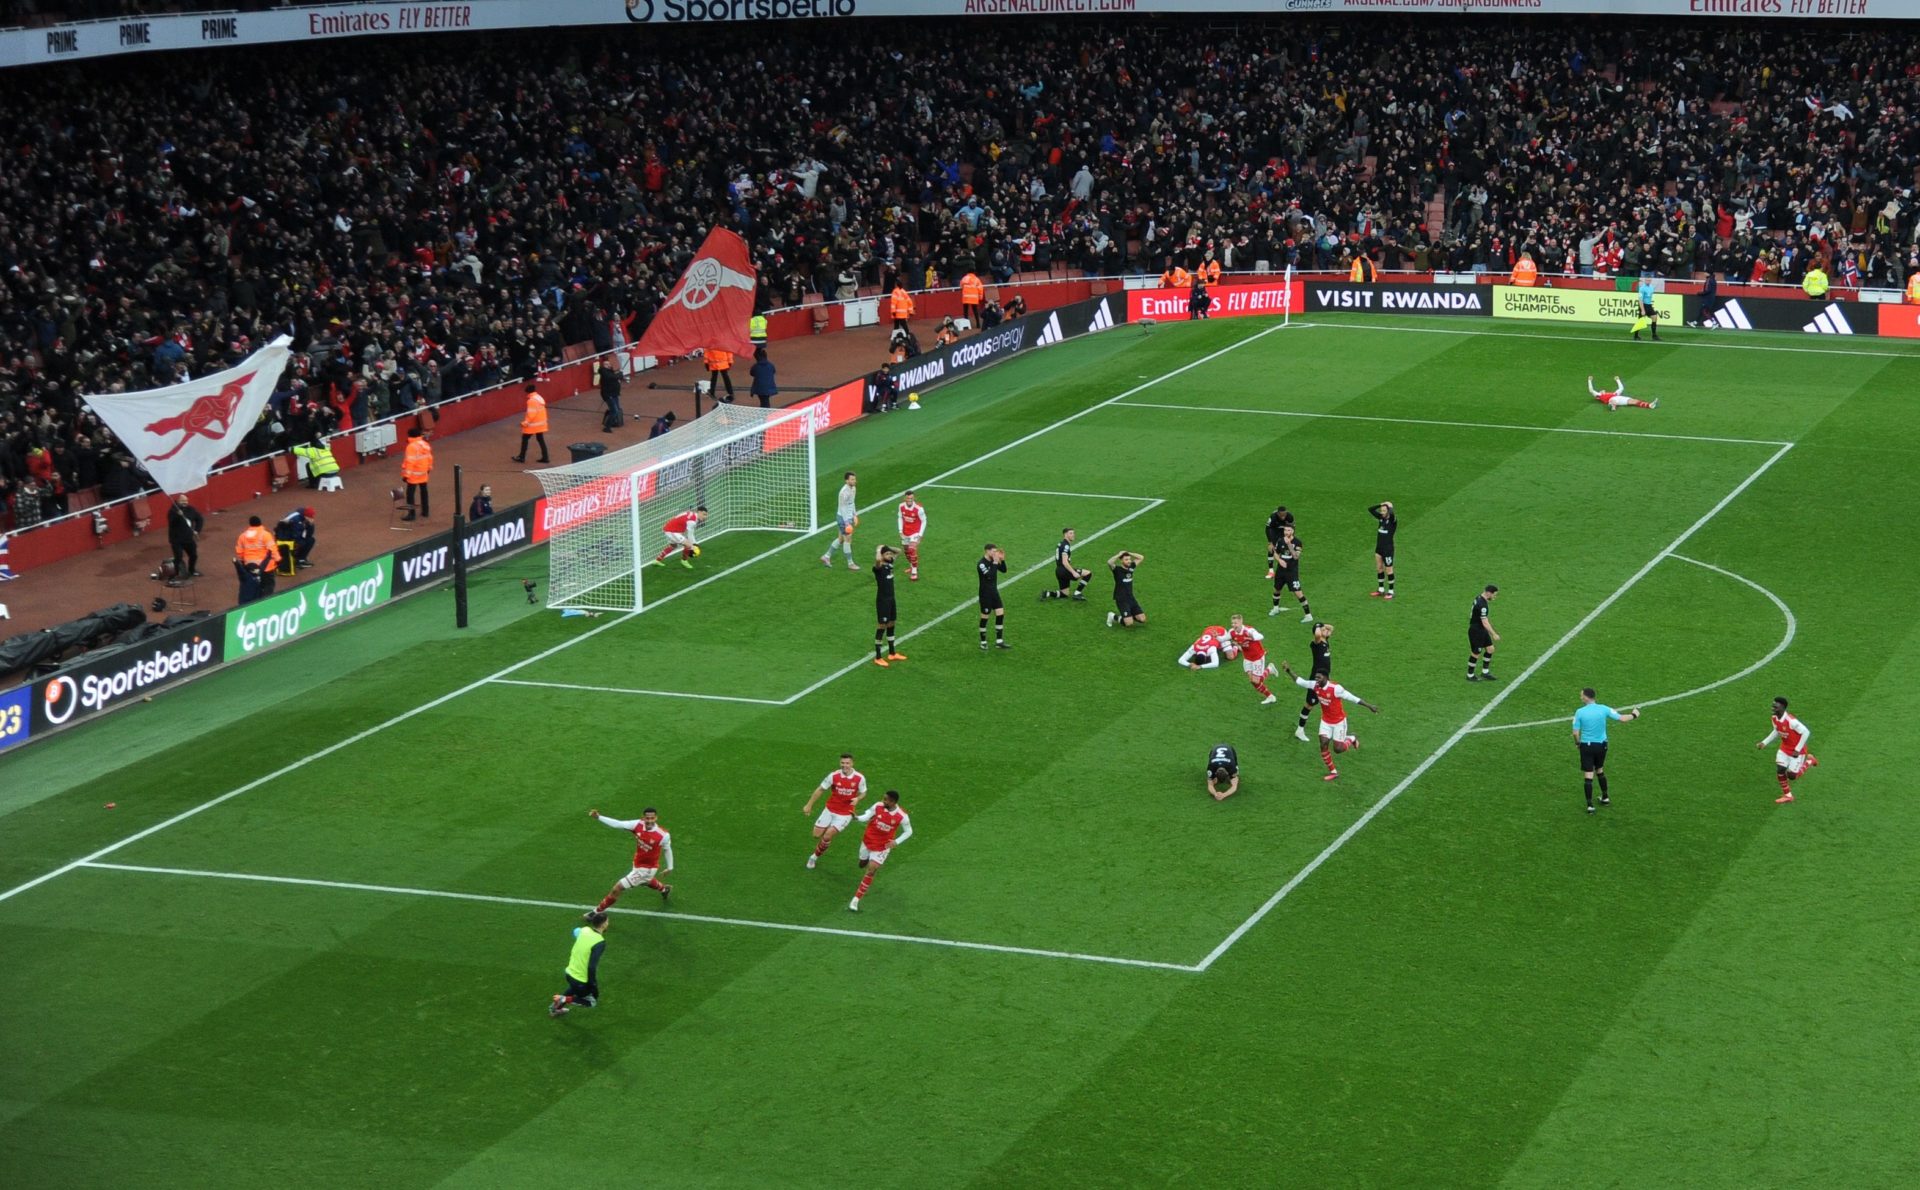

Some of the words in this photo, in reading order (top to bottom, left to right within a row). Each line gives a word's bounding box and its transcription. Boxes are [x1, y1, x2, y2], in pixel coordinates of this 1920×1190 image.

[202, 17, 238, 40] PRIME
[309, 11, 390, 35] Emirates
[398, 8, 420, 29] FLY
[424, 6, 471, 28] BETTER
[47, 30, 78, 54] PRIME
[119, 23, 150, 46] PRIME
[1141, 296, 1221, 315] Emirs
[1228, 293, 1248, 311] FLY
[1316, 290, 1373, 307] VISIT
[1382, 292, 1482, 309] RWANDA
[1505, 293, 1560, 304] ULTIMATE
[1505, 302, 1575, 315] CHAMPIONS
[1599, 298, 1654, 308] ULTIMA
[899, 358, 944, 391] RWANDA
[544, 493, 601, 531] Emirates
[402, 546, 448, 582] VISIT
[453, 518, 526, 564] WANDA
[81, 636, 212, 710] Sportsbet.io
